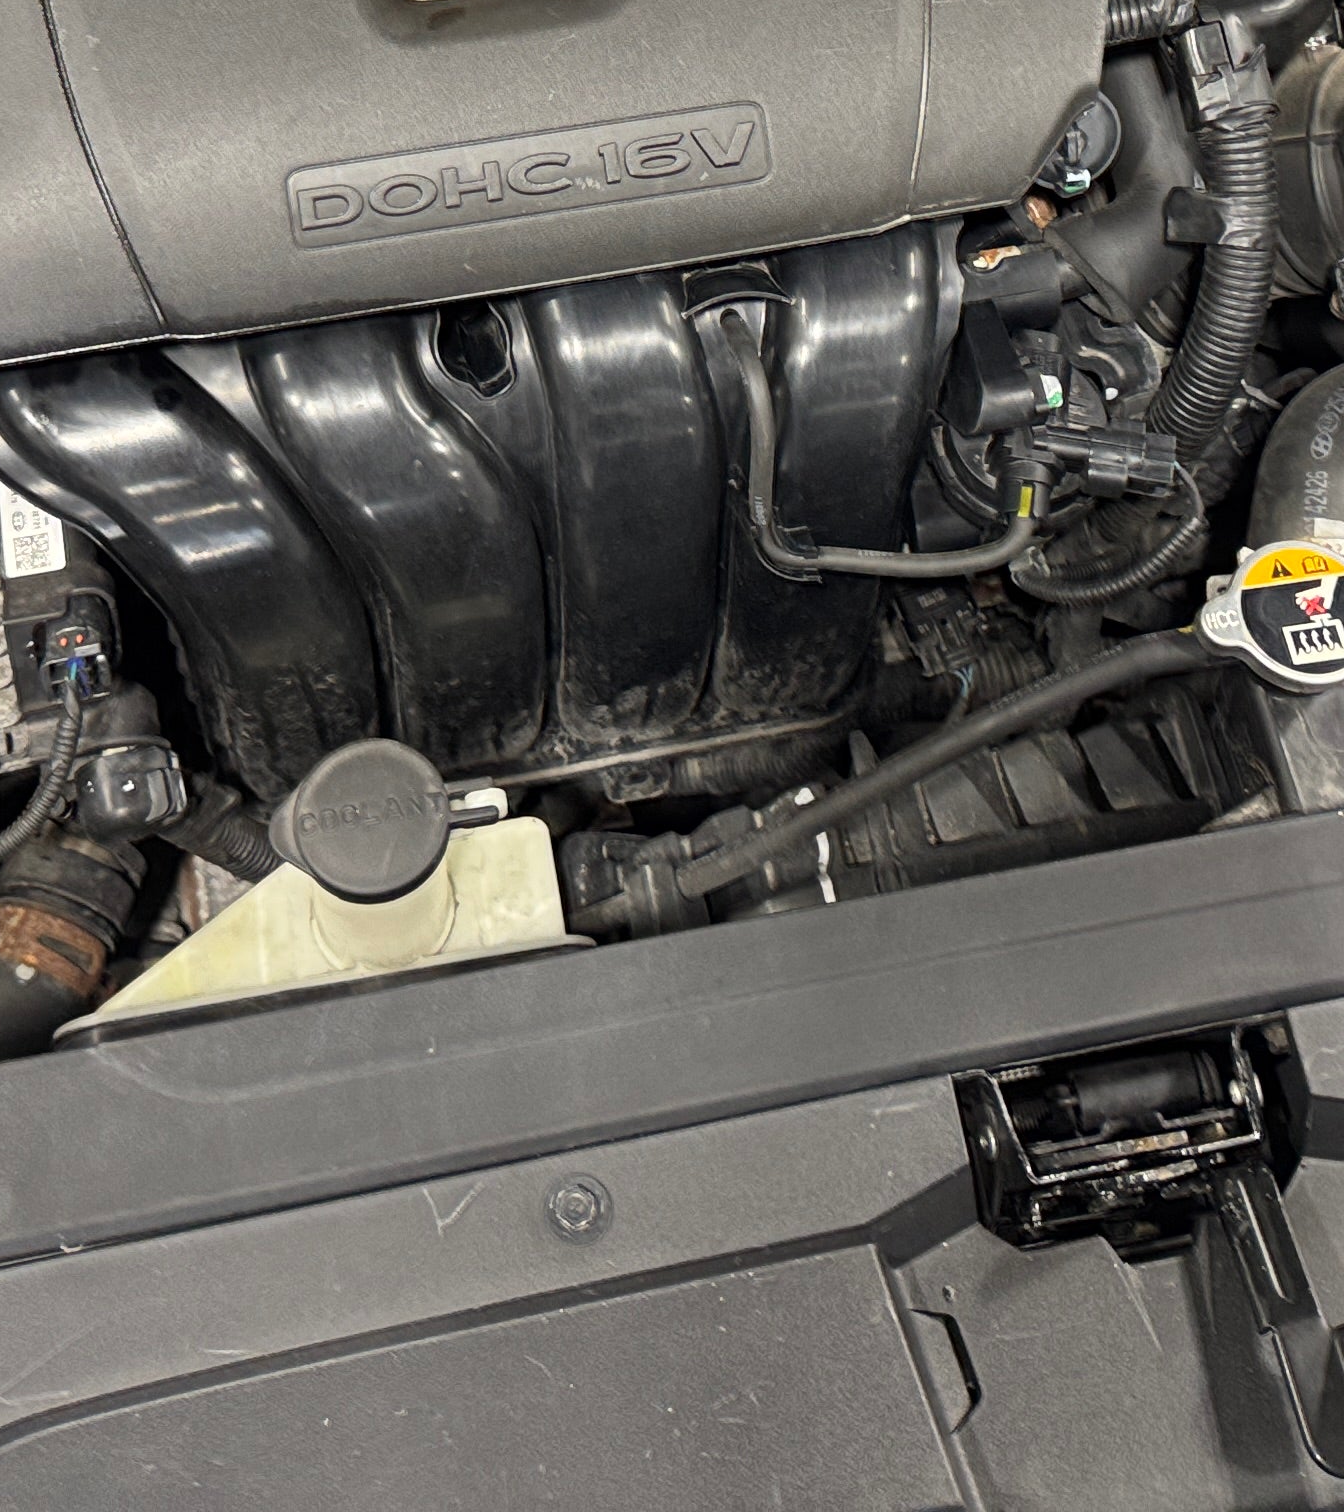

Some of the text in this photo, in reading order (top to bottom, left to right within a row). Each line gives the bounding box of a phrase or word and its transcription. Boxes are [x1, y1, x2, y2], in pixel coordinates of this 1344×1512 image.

[296, 121, 755, 232] DOHC 16V
[1205, 609, 1241, 631] HCC
[298, 791, 446, 837] COOLANT
